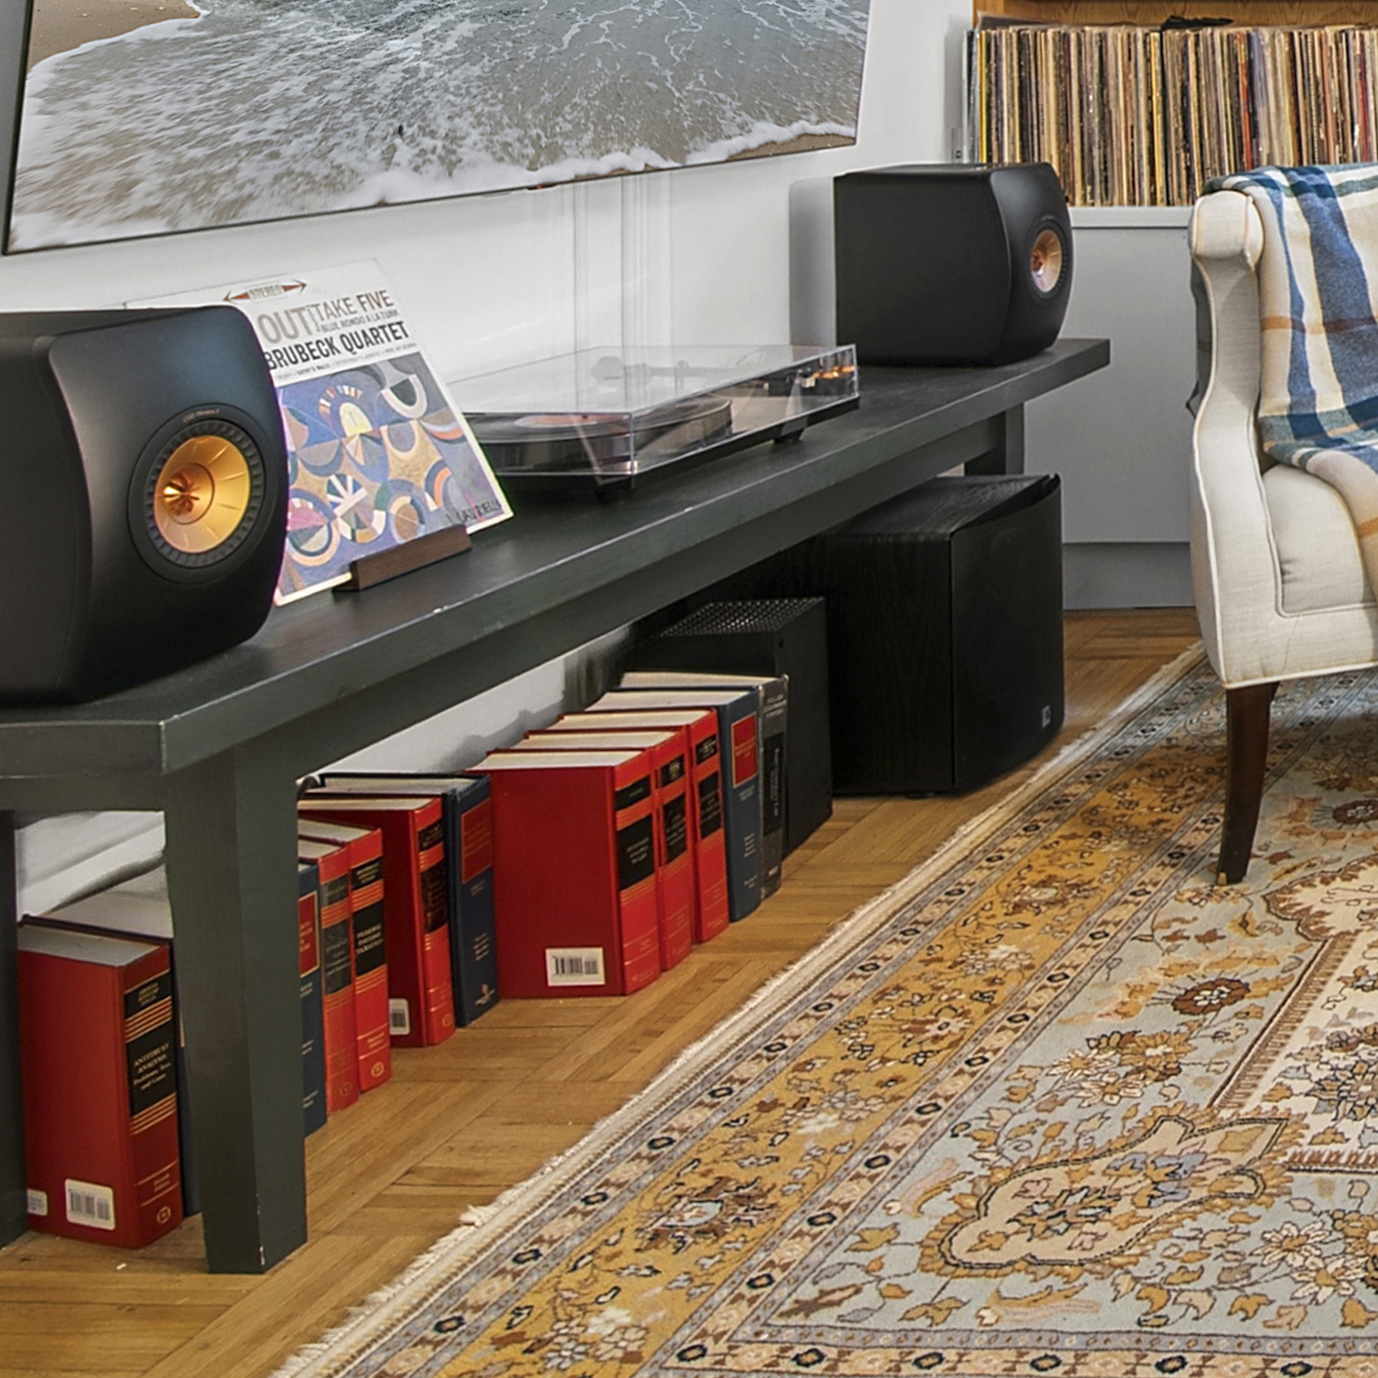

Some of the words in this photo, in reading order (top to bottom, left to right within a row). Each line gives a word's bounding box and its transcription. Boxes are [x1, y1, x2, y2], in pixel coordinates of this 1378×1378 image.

[250, 283, 283, 300] STEREO
[311, 298, 358, 322] TAKE
[356, 290, 394, 312] FIVE
[257, 306, 312, 344] OUT
[320, 322, 340, 333] BLUE
[340, 317, 367, 330] RONDO
[372, 314, 380, 322] LA
[382, 309, 400, 320] TURK
[262, 337, 341, 370] BRUBECK
[340, 321, 410, 355] QUARTET
[134, 1043, 169, 1066] ANTITRUST
